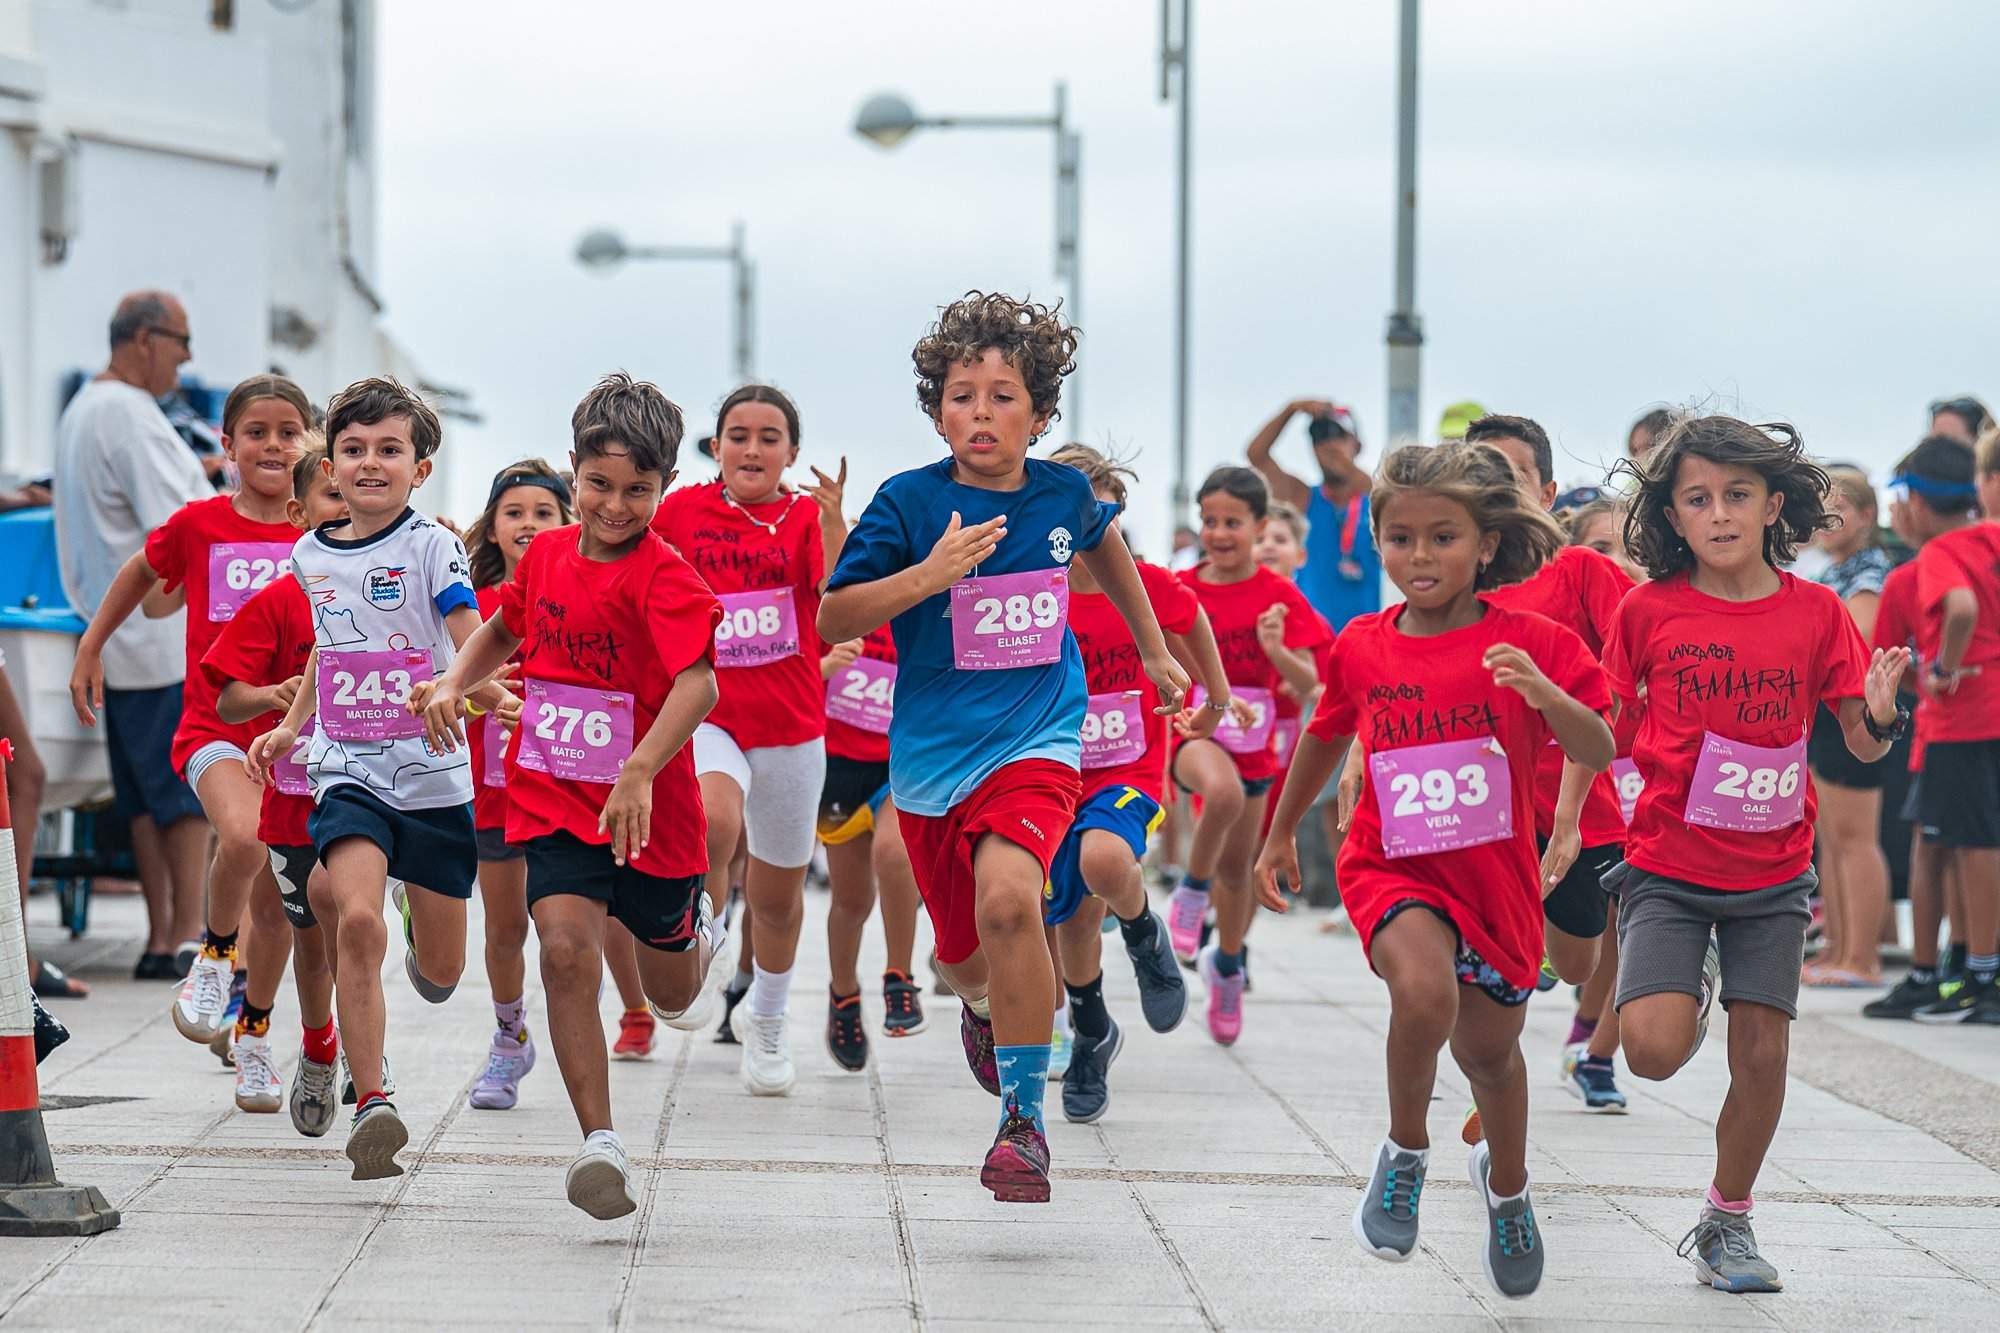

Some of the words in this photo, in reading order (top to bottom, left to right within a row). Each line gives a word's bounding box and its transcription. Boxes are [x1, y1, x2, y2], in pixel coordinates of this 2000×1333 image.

[973, 591, 1059, 634] 289
[997, 634, 1042, 648] ELIASET
[1668, 643, 1736, 662] LANZAROTE
[332, 670, 412, 706] 243
[841, 670, 894, 706] 24
[1671, 663, 1804, 715] FAMARA
[346, 709, 382, 720] MATEO
[384, 709, 400, 719] GS
[1734, 696, 1791, 724] TOTAL
[535, 702, 612, 747] 276
[1372, 700, 1503, 753] FAMARA
[550, 745, 586, 760] MATEO
[1087, 738, 1133, 753] VILLALBA
[1390, 764, 1489, 817] 293
[1713, 761, 1800, 801] 286
[1425, 814, 1461, 829] VERA
[1742, 803, 1773, 814] GAEL
[1021, 818, 1045, 841] KIPSTA
